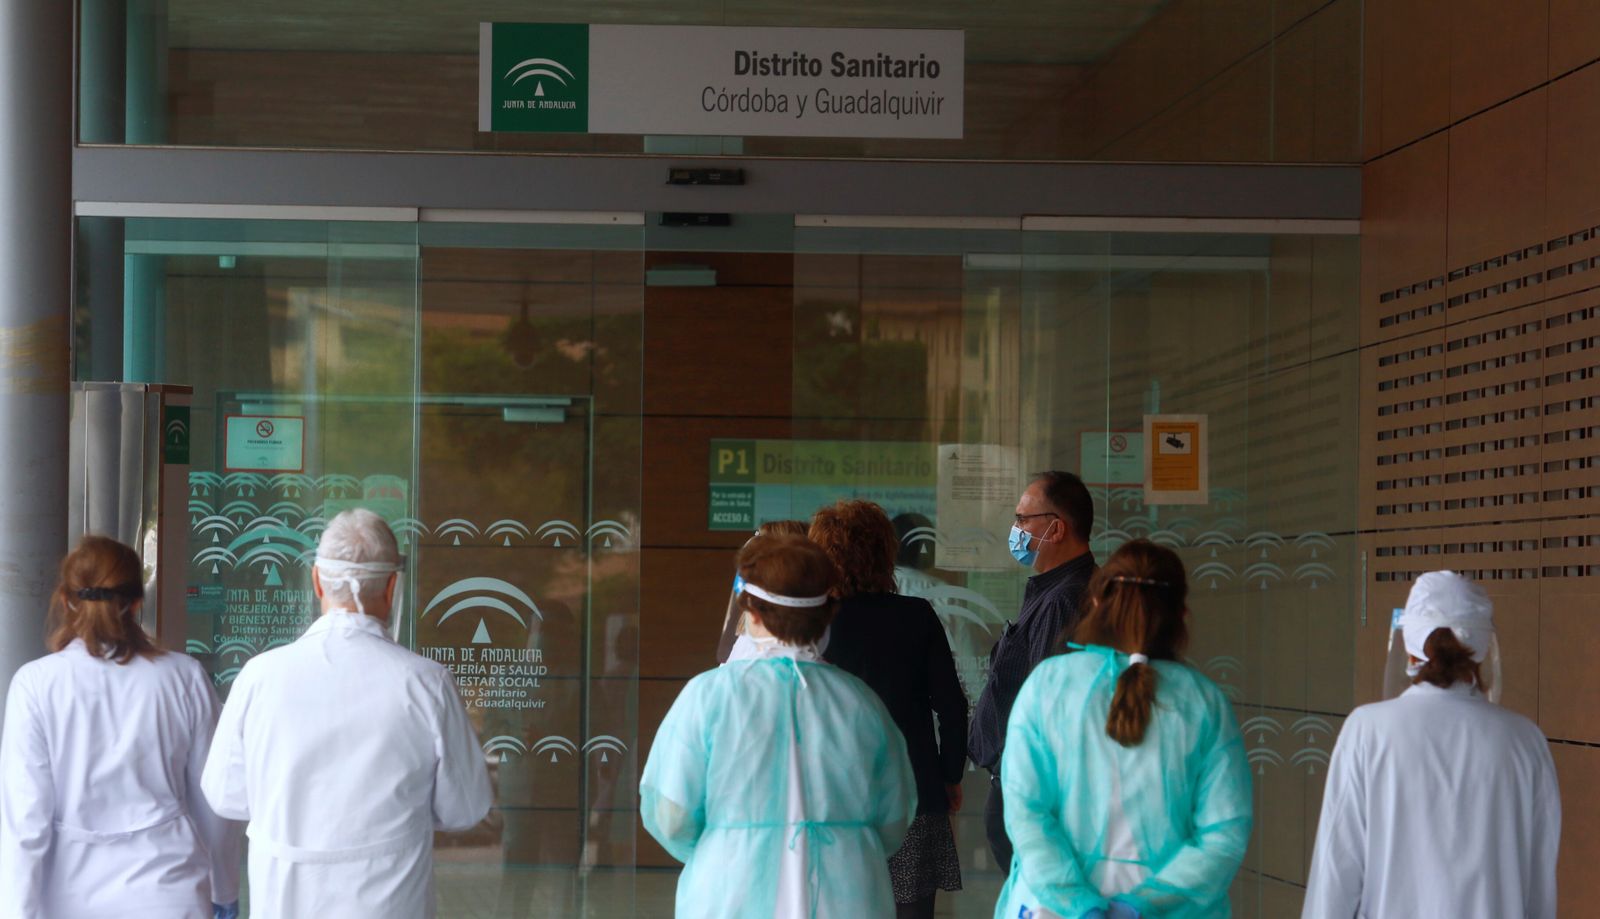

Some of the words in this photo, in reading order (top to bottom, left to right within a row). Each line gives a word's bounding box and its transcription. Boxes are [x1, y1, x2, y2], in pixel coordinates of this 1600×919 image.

[734, 50, 822, 76] Distrito
[831, 51, 940, 79] Sanitario
[502, 100, 524, 109] JUNTA
[527, 100, 536, 109] DE
[701, 85, 788, 113] Córdoba
[796, 94, 807, 119] y
[815, 88, 944, 121] Guadalquivir
[718, 449, 749, 475] P1
[763, 453, 835, 476] Distrito
[843, 454, 931, 478] Sanitario
[713, 512, 742, 523] ACCESO
[225, 589, 250, 602] NTA
[255, 589, 268, 602] DE
[272, 589, 314, 603] ANDALU
[225, 603, 279, 614] NSEJERÍA
[281, 605, 296, 614] DE
[220, 615, 227, 624] Y
[229, 615, 287, 625] BIENESTAR
[232, 625, 268, 634] Distrito
[461, 648, 475, 662] DE
[481, 648, 543, 663] ANDALUCIA
[446, 662, 487, 675] EJERÍA
[490, 665, 506, 675] DE
[508, 665, 548, 676] SALUD
[456, 676, 496, 687] ESTAR
[498, 677, 541, 688] SOCIAL
[478, 688, 527, 698] Sanitario
[465, 700, 473, 710] y
[474, 699, 546, 711] Guadalquivir
